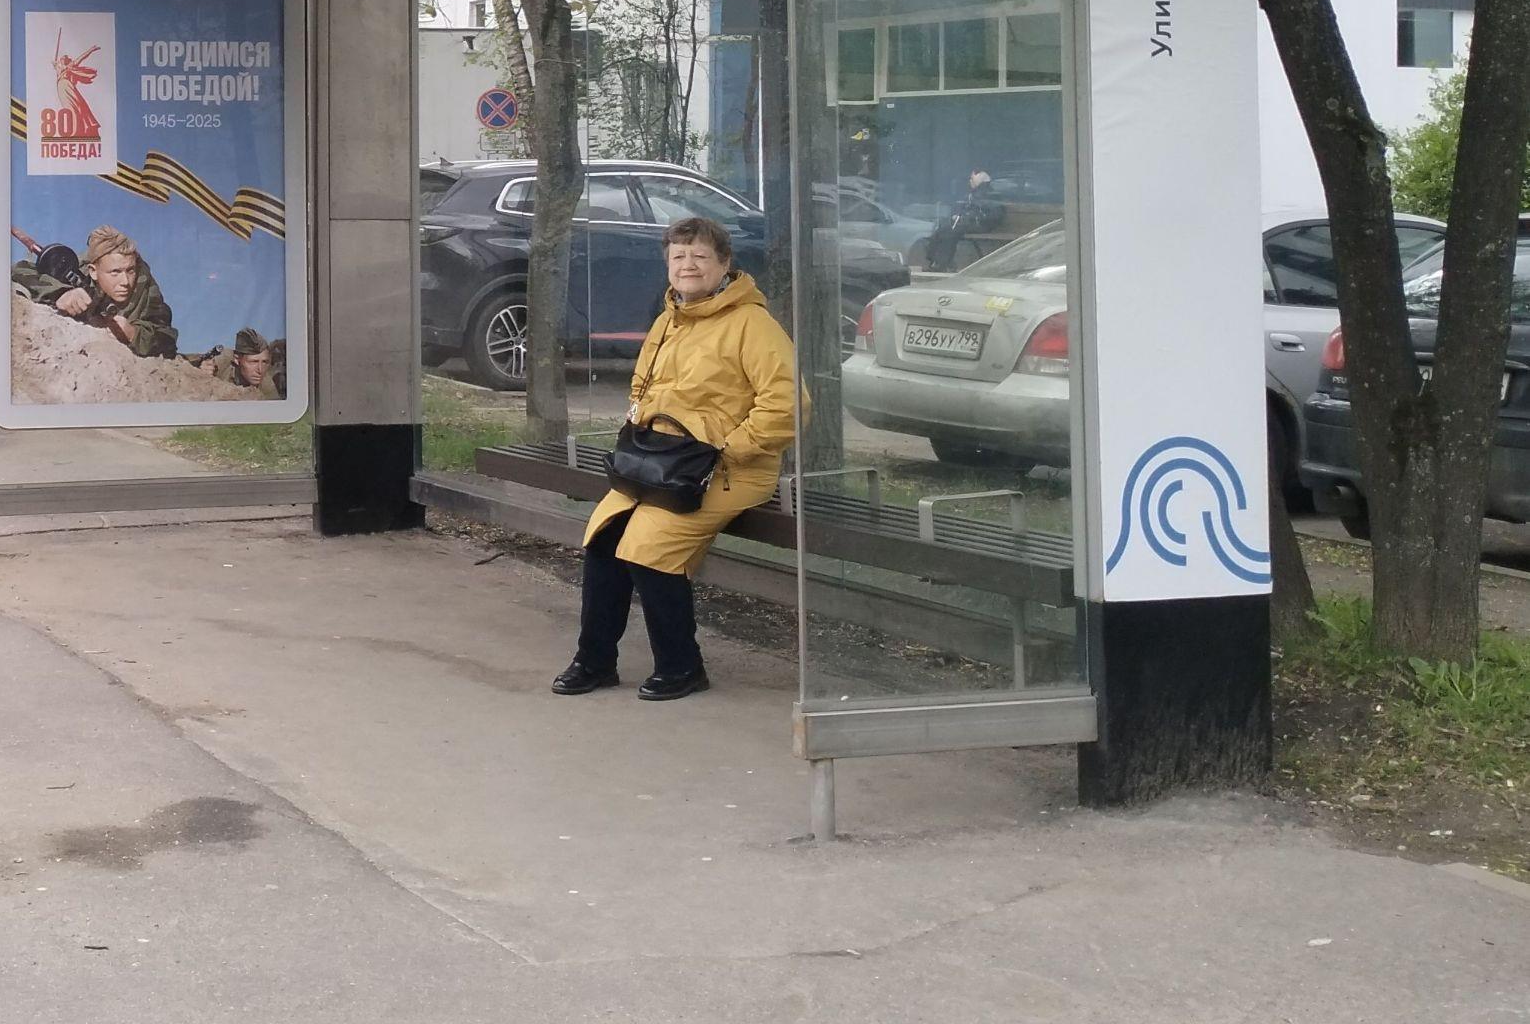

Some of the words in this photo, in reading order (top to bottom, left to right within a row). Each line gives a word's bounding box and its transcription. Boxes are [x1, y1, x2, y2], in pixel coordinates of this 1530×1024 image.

[140, 40, 270, 71] ГОРДИМСЯ
[141, 72, 260, 106] ПОБЕДОЙ!
[41, 108, 74, 137] 80
[41, 143, 102, 160] ПОБЕДА!
